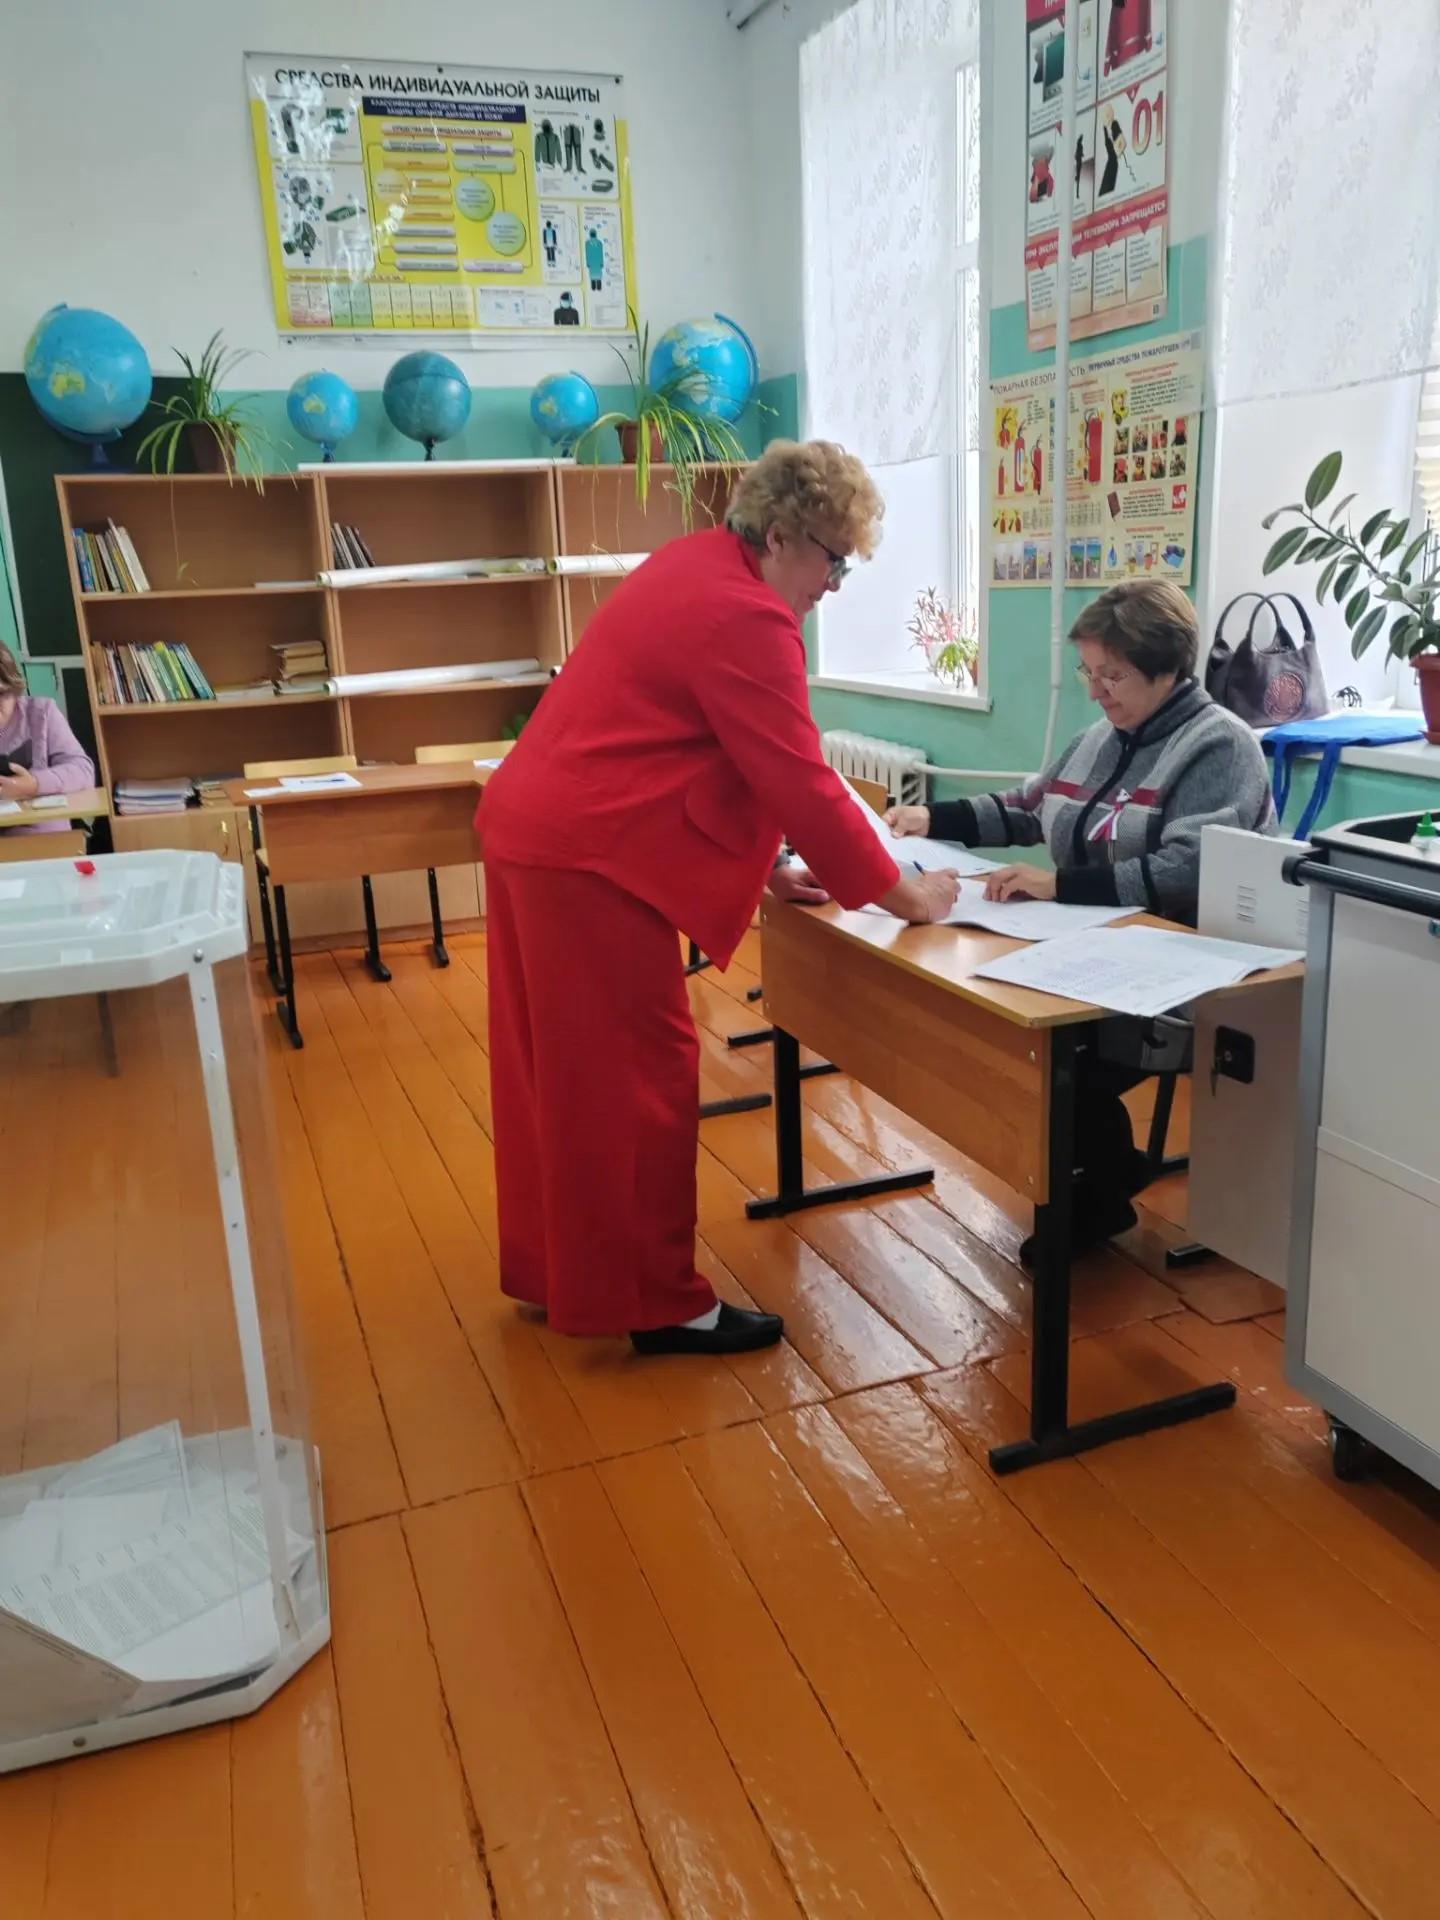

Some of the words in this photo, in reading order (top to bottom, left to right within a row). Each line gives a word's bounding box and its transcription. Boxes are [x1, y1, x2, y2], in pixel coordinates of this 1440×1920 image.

[368, 73, 530, 99] ИНДИВИДУАЛЬНОЙ
[534, 84, 601, 104] ЗАЩИТЫ
[1132, 91, 1164, 156] 01
